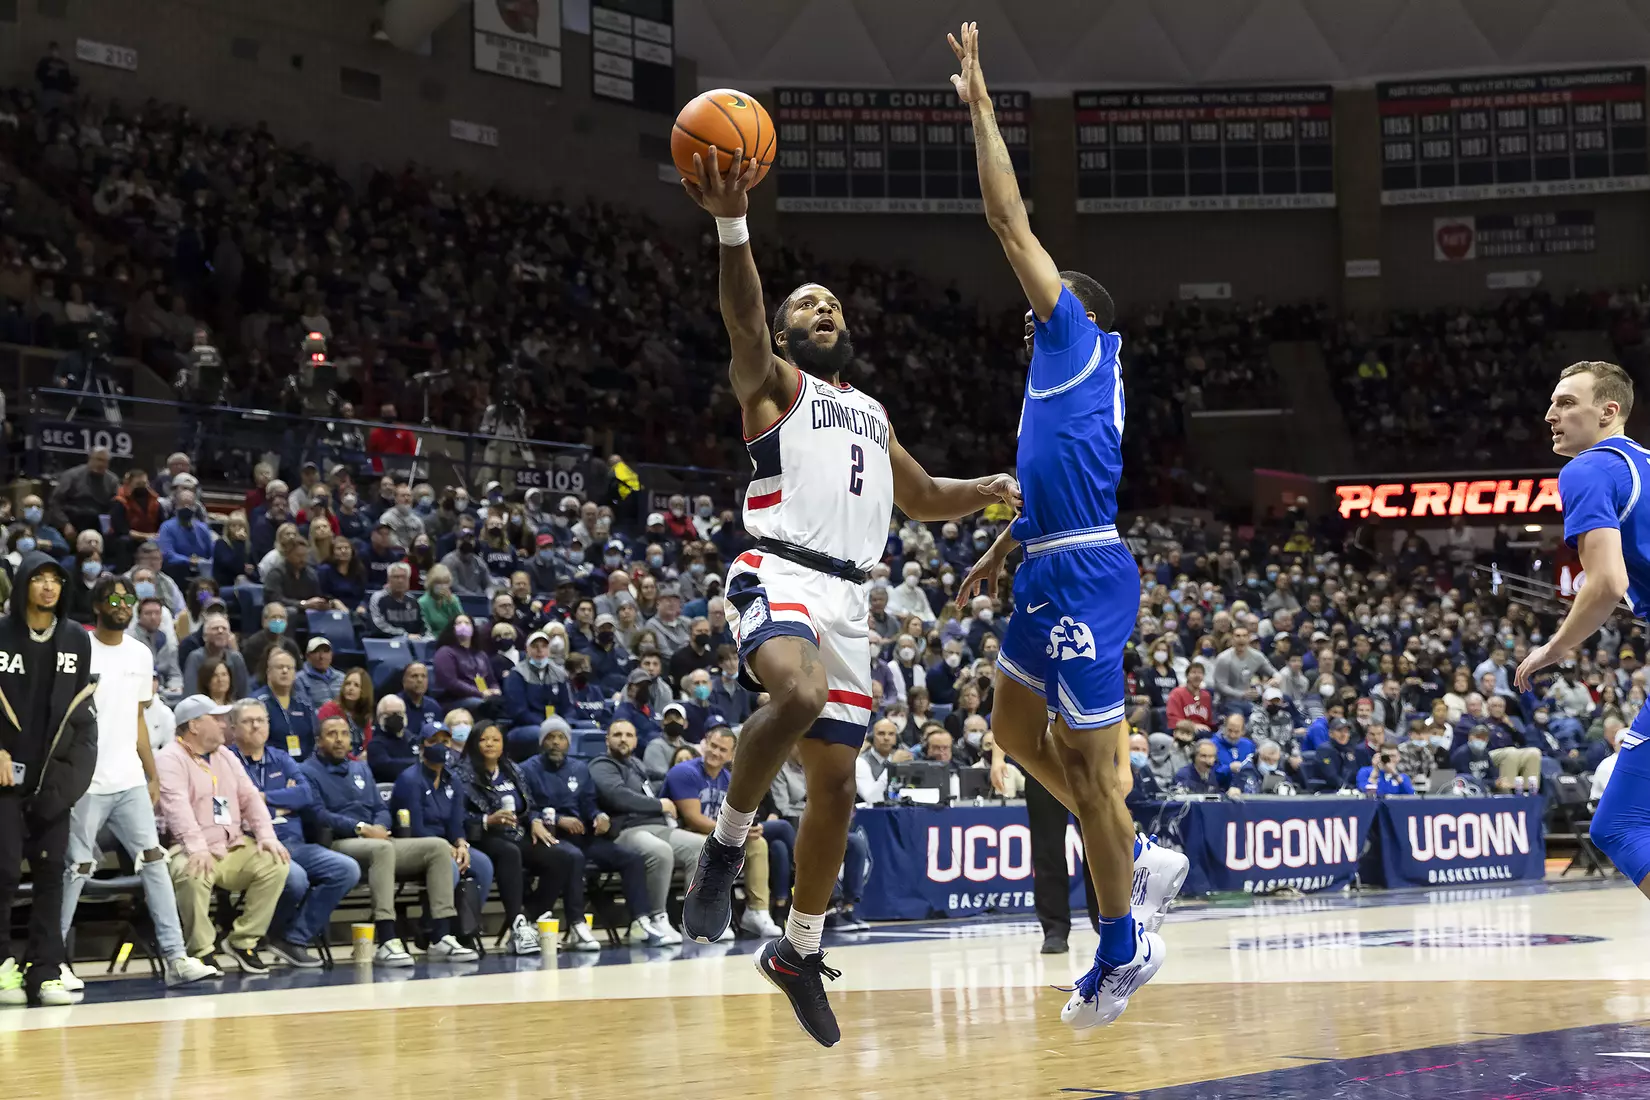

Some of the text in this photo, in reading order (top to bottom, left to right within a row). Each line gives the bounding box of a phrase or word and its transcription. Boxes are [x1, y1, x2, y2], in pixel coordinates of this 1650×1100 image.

[1389, 71, 1633, 98] NATIONAL INVITATION TOURNAMENT
[779, 91, 1025, 108] BIG EAST CONFECE
[779, 110, 1026, 122] REGULAR SEASON CHAMONS
[1098, 106, 1310, 121] TOURNAMENT CHAMPIONS
[811, 399, 889, 455] CONNECTICUT
[42, 428, 134, 455] SEC 109
[516, 470, 584, 492] SEC 109
[848, 442, 865, 497] 2
[1336, 478, 1564, 519] P.C. RICHA
[56, 651, 78, 674] PE
[1225, 816, 1358, 872] UCONN
[1407, 810, 1530, 863] UCONN
[926, 823, 1084, 883] UCON
[1243, 874, 1335, 895] BASKETBALL
[1428, 864, 1513, 885] BASKETBALL
[948, 891, 1035, 910] BASKETB
